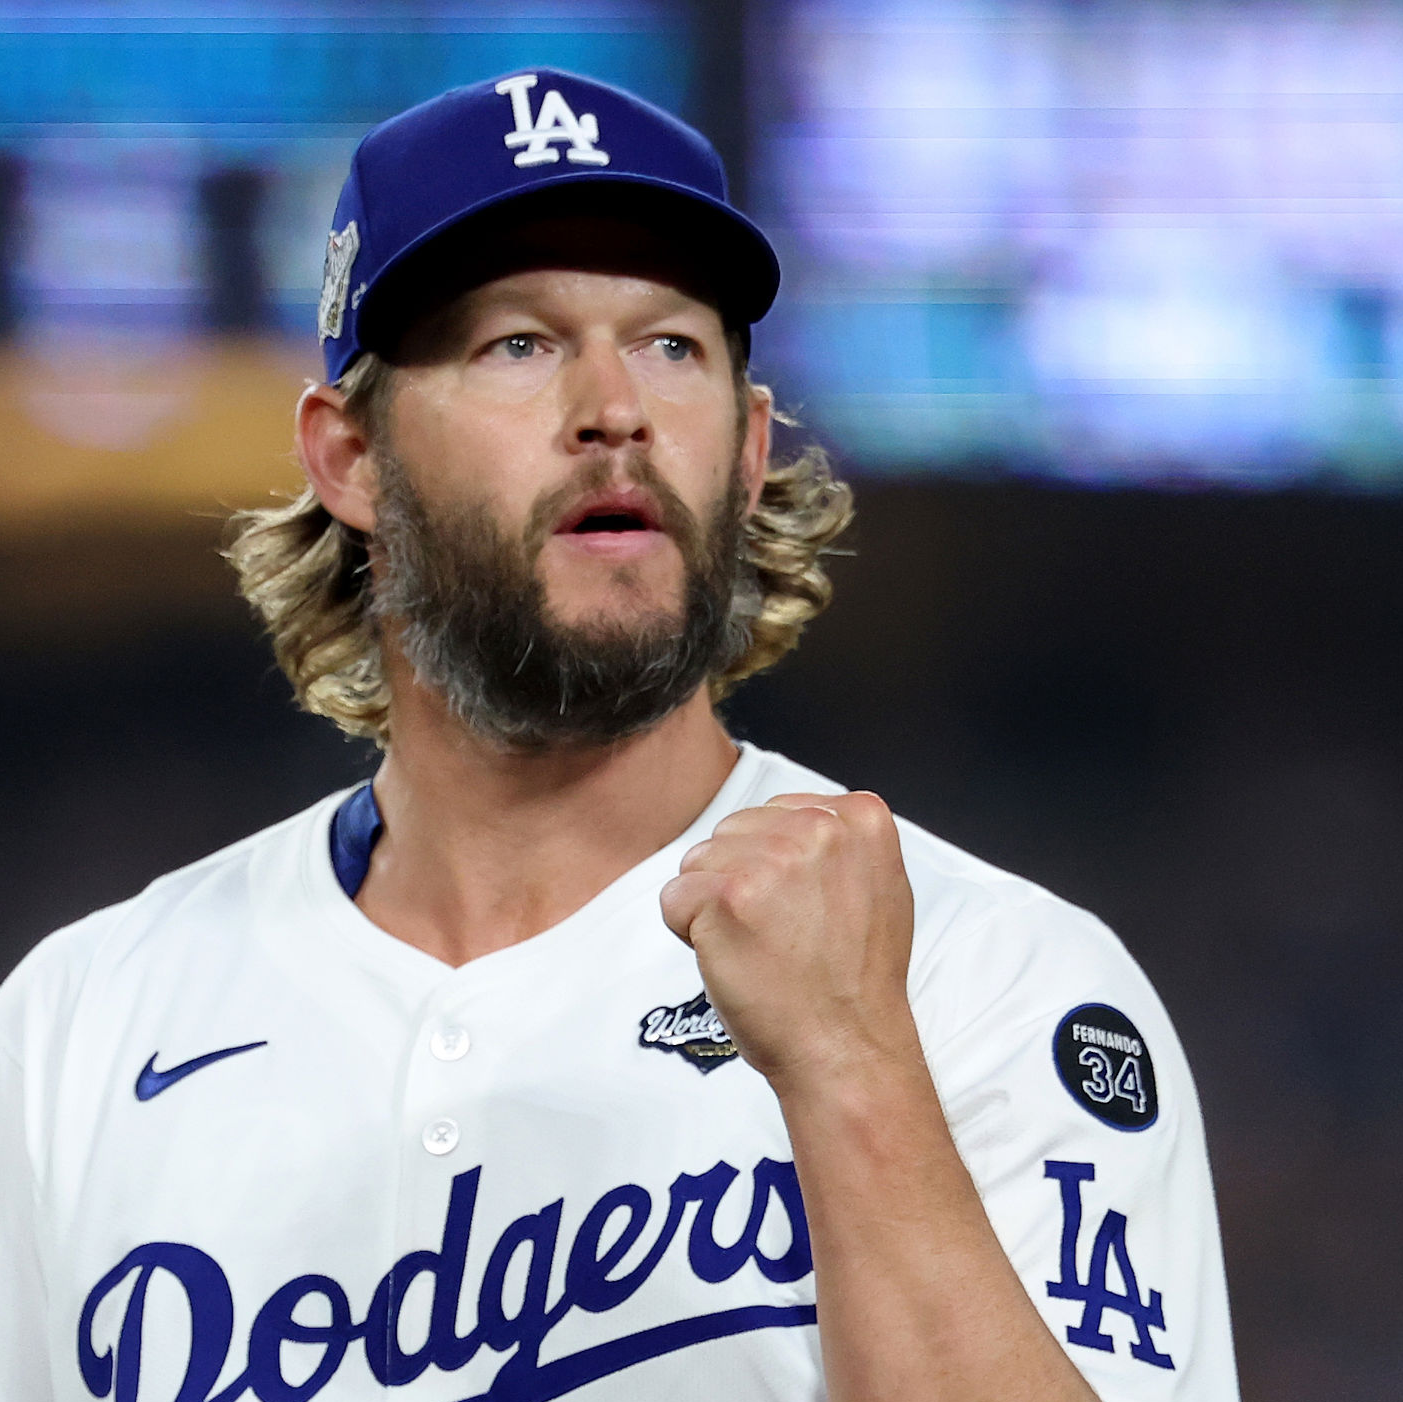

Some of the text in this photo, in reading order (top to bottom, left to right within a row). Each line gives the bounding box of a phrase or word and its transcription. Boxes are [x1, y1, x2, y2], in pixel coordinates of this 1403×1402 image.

[495, 75, 610, 168] LA
[1072, 1023, 1143, 1057] FERNANDO
[1078, 1046, 1147, 1113] 34
[1044, 1160, 1175, 1371] LA
